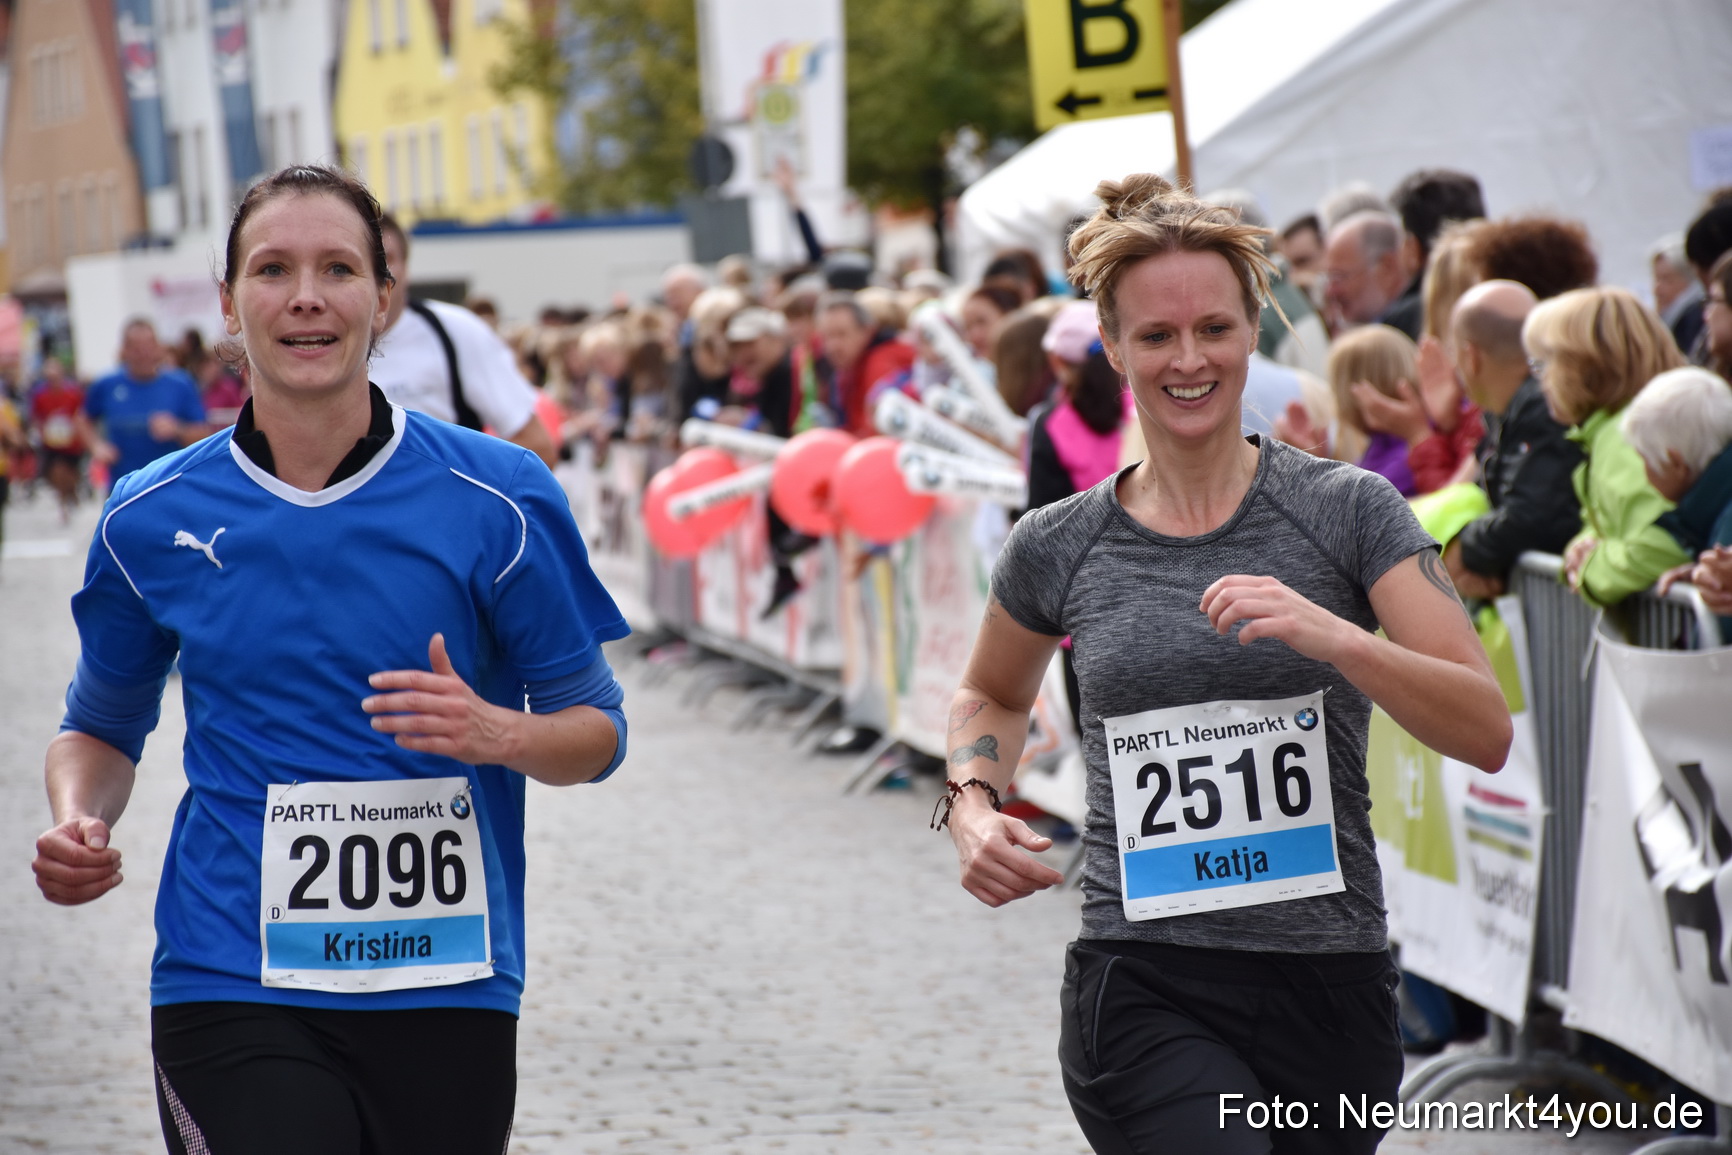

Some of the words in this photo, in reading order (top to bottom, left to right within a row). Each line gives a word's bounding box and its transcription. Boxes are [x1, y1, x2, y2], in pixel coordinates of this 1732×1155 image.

[1070, 0, 1140, 69] B
[1113, 729, 1179, 756] PARTL
[1183, 716, 1288, 744] Neumarkt
[1136, 741, 1312, 838] 2516
[271, 804, 345, 823] PARTL
[351, 801, 445, 823] Neumarkt
[1127, 836, 1136, 849] D
[287, 829, 467, 911] 2096
[1193, 846, 1270, 882] Katja
[271, 907, 280, 920] D
[323, 930, 432, 963] Kristina
